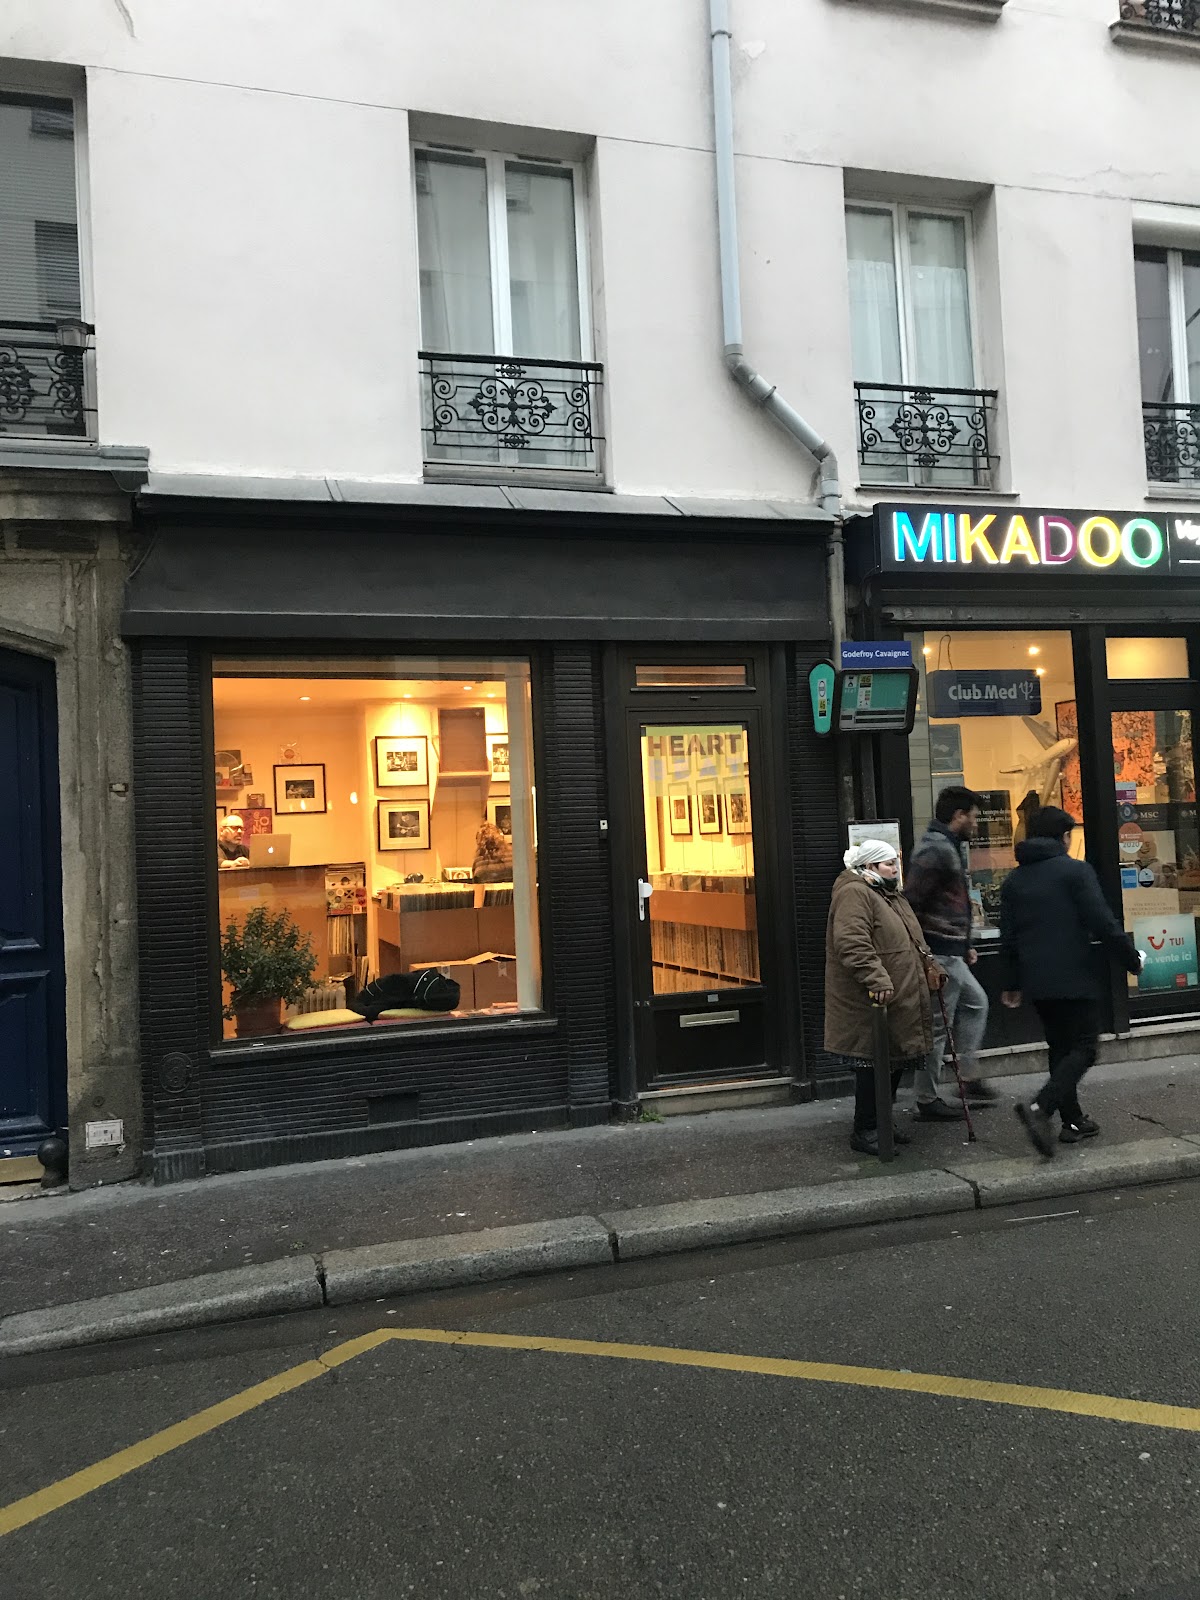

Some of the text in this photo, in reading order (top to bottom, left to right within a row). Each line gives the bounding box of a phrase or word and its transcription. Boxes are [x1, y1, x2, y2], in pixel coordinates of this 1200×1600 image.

[893, 511, 1163, 568] MIKADOO
[842, 649, 910, 659] Godefroy Cavaignac
[948, 683, 1017, 700] Club Med
[649, 734, 742, 755] HEART
[1140, 811, 1159, 819] MSC
[1122, 841, 1140, 849] 2020
[1169, 937, 1185, 946] TUI
[1155, 953, 1180, 963] vente
[1182, 951, 1192, 961] ici
